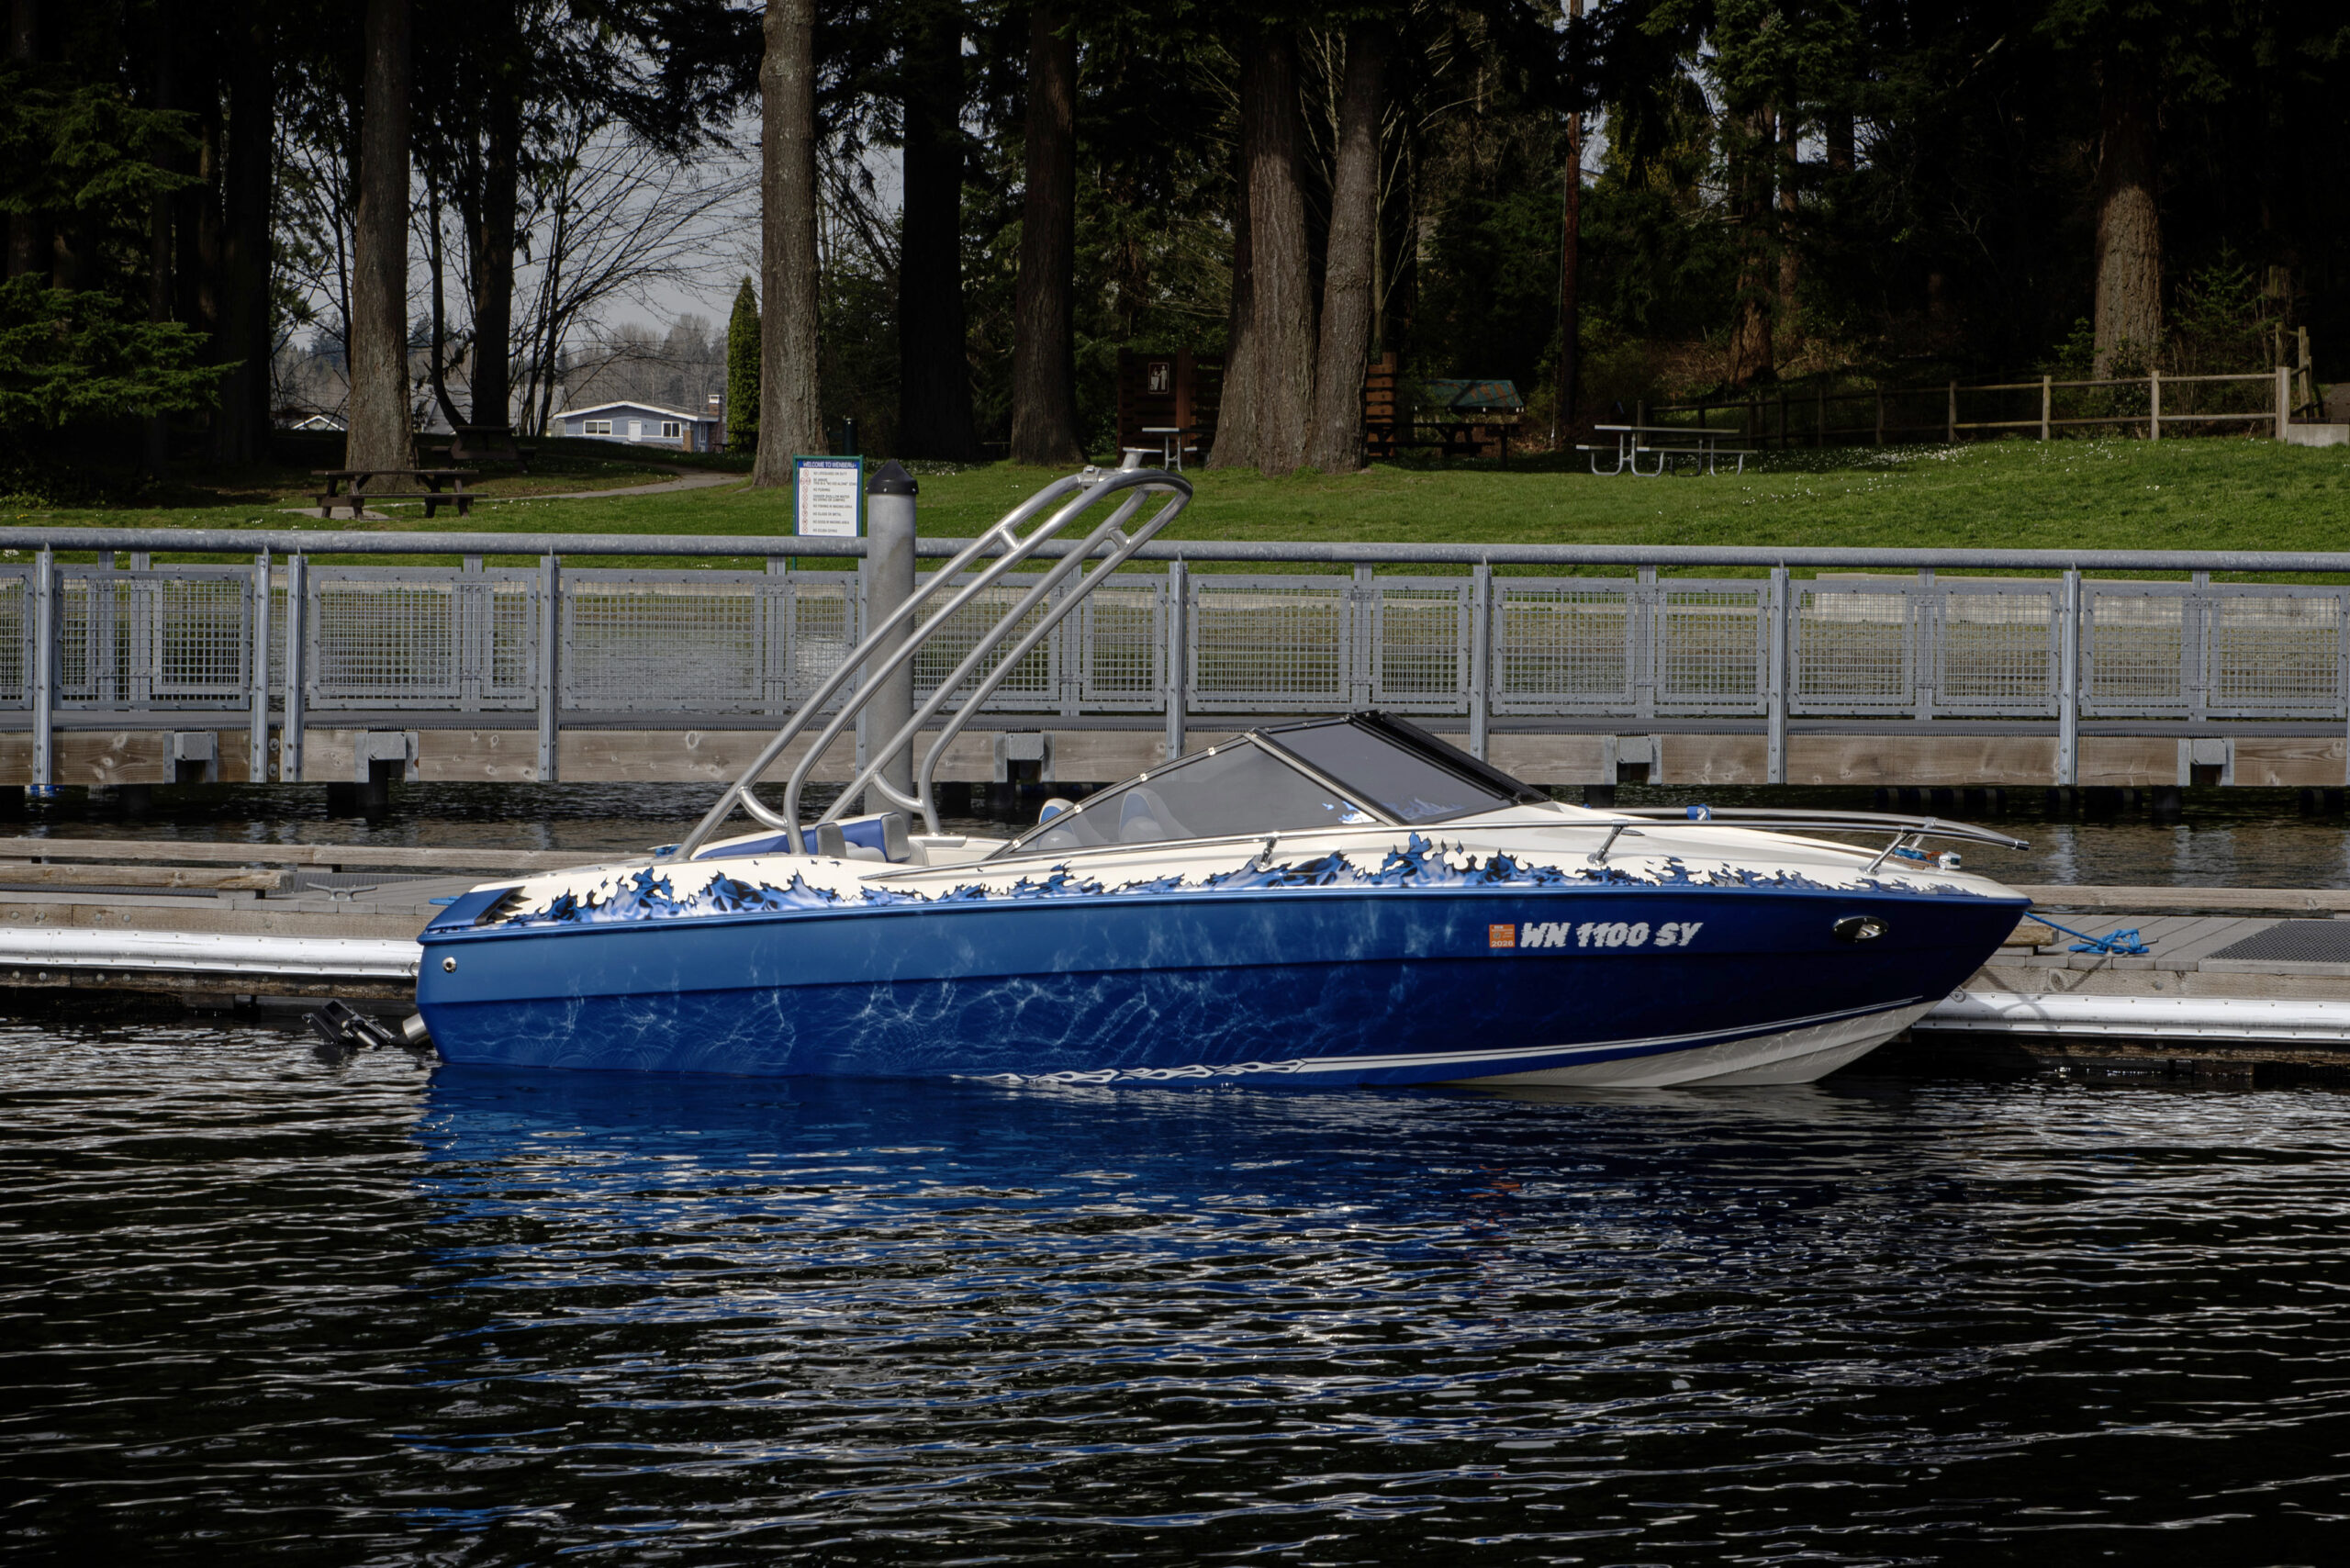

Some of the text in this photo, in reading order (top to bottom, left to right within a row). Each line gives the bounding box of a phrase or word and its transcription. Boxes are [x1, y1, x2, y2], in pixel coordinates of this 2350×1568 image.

[1520, 923, 1703, 947] WN 1100 SY
